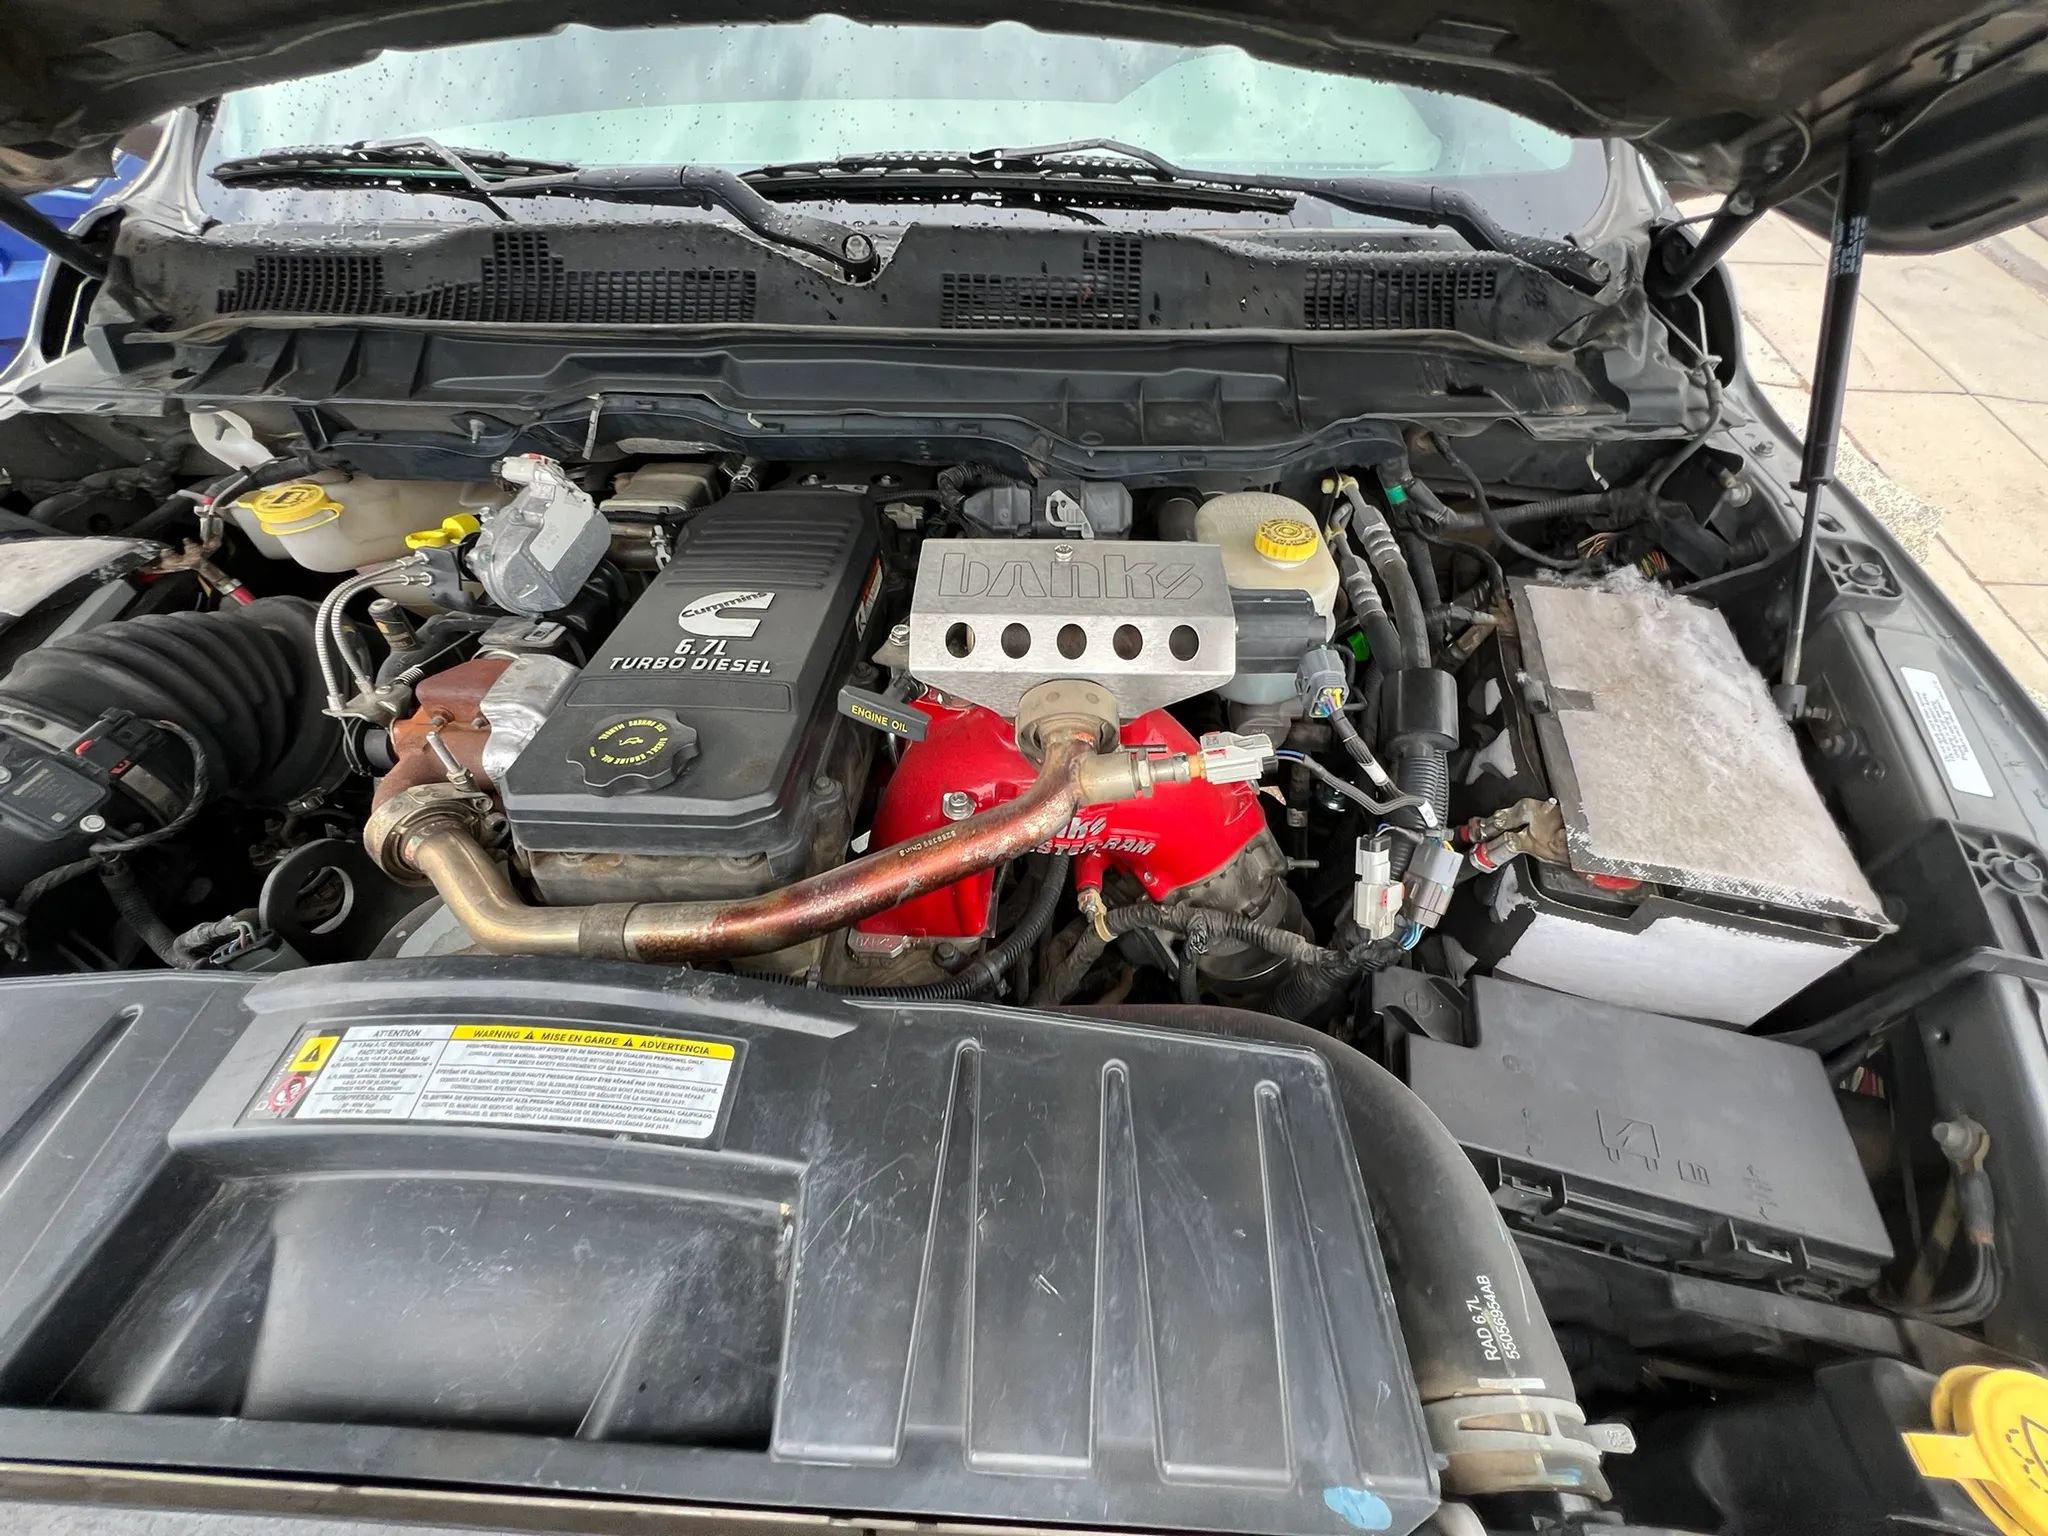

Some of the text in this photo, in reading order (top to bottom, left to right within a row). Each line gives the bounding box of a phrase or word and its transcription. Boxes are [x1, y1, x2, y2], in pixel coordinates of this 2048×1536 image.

[681, 591, 768, 618] Cummins
[674, 638, 729, 656] 6.7L
[609, 657, 772, 674] TURBO DIESEL
[851, 704, 909, 733] ENGINE OIL
[898, 843, 923, 857] China
[372, 1029, 422, 1037] ATTENTION
[473, 1029, 710, 1055] WARNING MISE EN GARDE ADVERTENCIA
[1465, 1295, 1501, 1361] RAD 6.7L
[1476, 1274, 1520, 1360] 55056954AB
